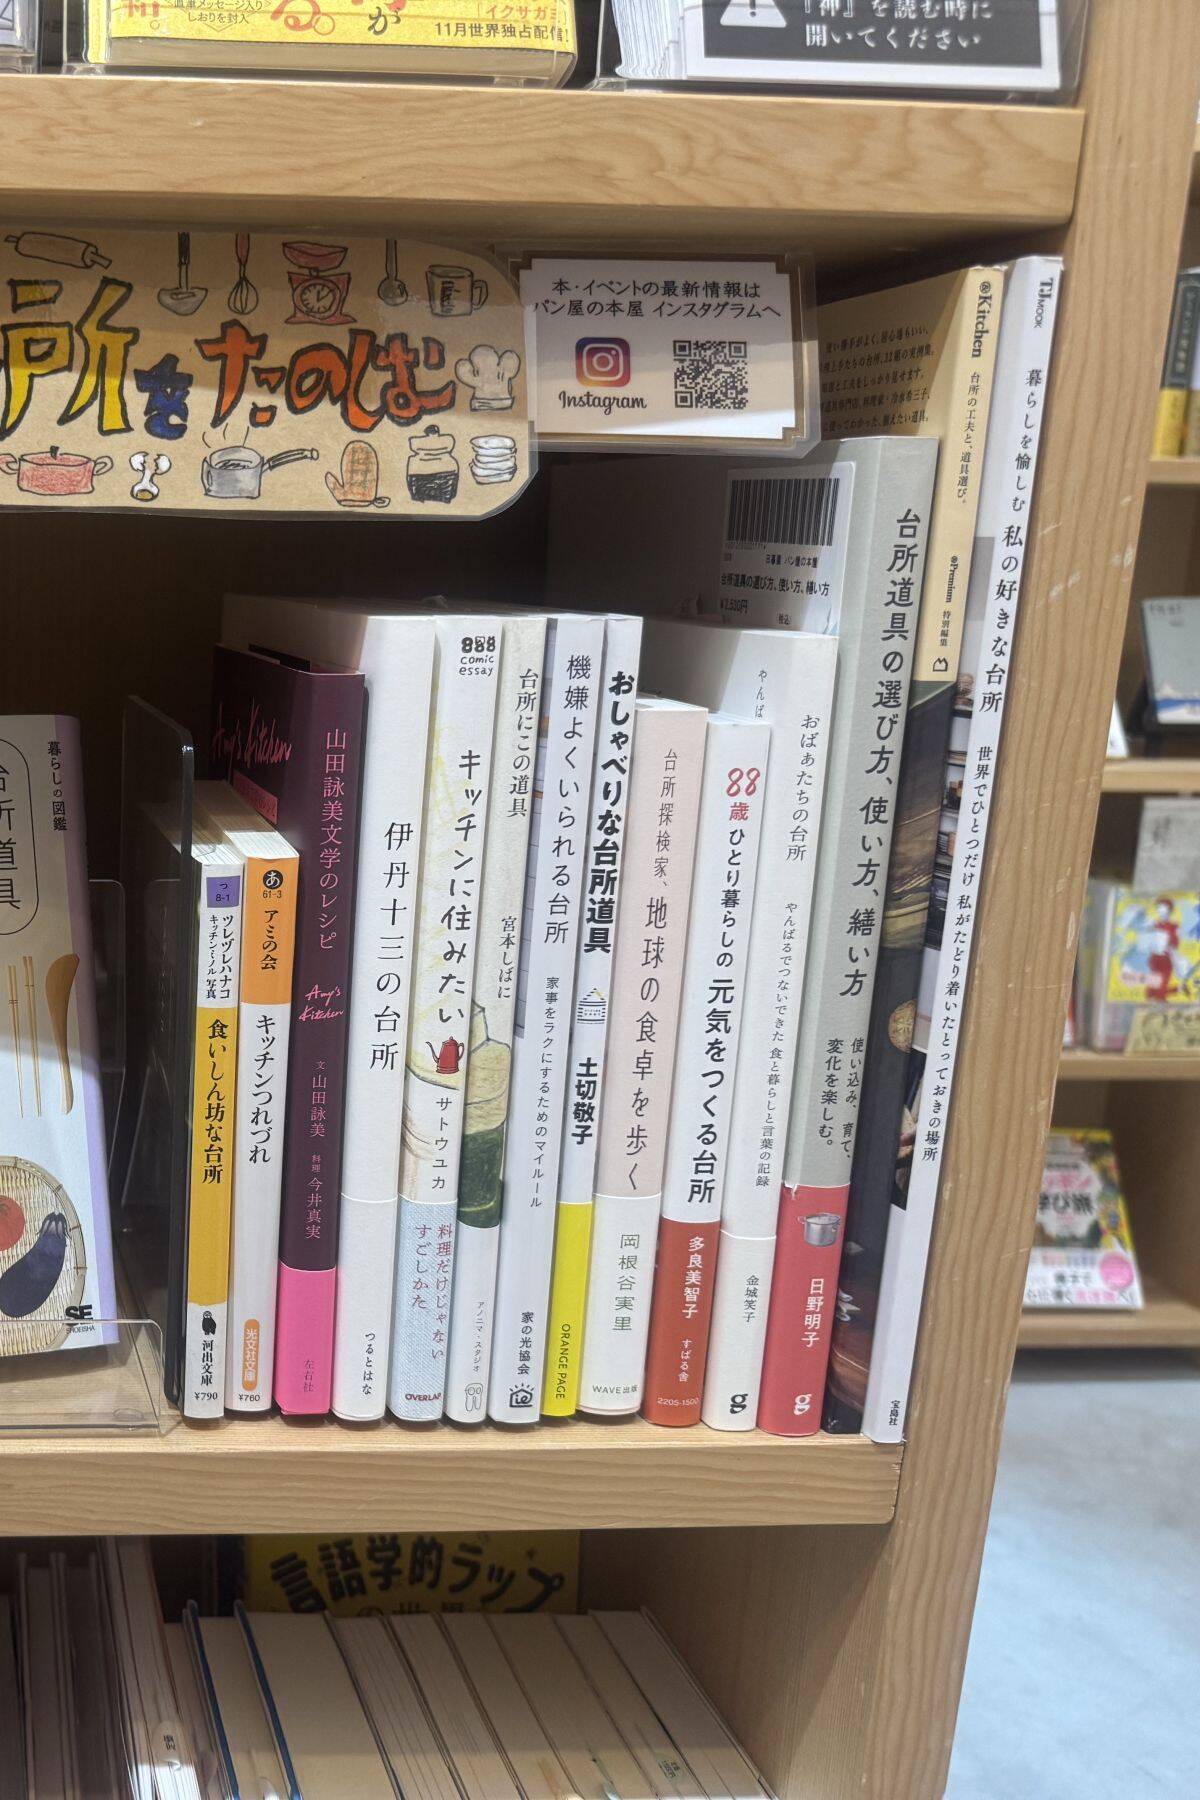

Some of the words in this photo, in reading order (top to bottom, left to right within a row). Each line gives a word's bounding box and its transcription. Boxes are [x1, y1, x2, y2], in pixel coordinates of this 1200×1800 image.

[187, 11, 251, 25] しおりを封入
[804, 23, 982, 49] 開いてください
[532, 299, 645, 318] パン屋の本屋
[652, 300, 783, 320] インスタグラムへ
[551, 276, 762, 299] 本・イベントの最新情報は
[558, 389, 648, 416] Instagram
[956, 371, 981, 504] 台所の工夫と、道具選び。
[1011, 368, 1043, 513] 暮らしを愉しむ
[460, 654, 495, 665] comic
[978, 525, 1025, 714] 私の好きな台所
[458, 666, 494, 677] essay
[507, 667, 540, 819] 台所にこの道具
[837, 507, 922, 997] 台所道具の選び方、使い方、繕い方
[47, 740, 68, 832] 暮らしの図鑑
[544, 653, 592, 945] 機嫌よくいられる台所
[583, 670, 636, 954] おしゃべりな台所道具
[785, 714, 821, 863] おばあたちの台所
[961, 746, 994, 886] 世界でひとつだけ
[265, 871, 281, 888] あ
[318, 727, 347, 950] 山田詠美文学のレシピ
[215, 893, 231, 902] 8-1
[262, 889, 283, 900] 61-3
[438, 749, 483, 1024] キッチンに住みたい
[219, 914, 235, 1000] ツレヅレハナコ
[260, 910, 280, 971] アミの会
[369, 821, 414, 1071] 伊丹十三の台所
[497, 915, 518, 1000] 宮本しばに
[771, 902, 799, 1043] やんばるでつないできた
[298, 1004, 345, 1022] Kitchen
[304, 984, 342, 1007] Amy's
[921, 894, 972, 1163] 私がたどり着いたとっておきの場所
[202, 1018, 230, 1185] 食いしん坊な台所
[248, 1014, 277, 1165] キッチンつれづれ
[309, 1073, 328, 1138] 山田詠美
[315, 1060, 326, 1070] 文
[530, 976, 560, 1208] 家事をラクにするためのマイルール
[571, 1056, 599, 1146] 土切敬子
[818, 1038, 844, 1147] 変化を楽しむ。
[431, 1096, 453, 1191] サトウユカ
[755, 1047, 784, 1188] 食と暮らしと言葉の記録
[310, 1153, 322, 1173] 料理
[305, 1176, 323, 1240] 今井真実
[411, 1223, 432, 1310] すごしかた
[431, 1223, 453, 1361] 料理だけじゃない
[611, 1233, 641, 1332] 岡根谷実里
[681, 1236, 706, 1319] 多良美智子
[742, 1274, 760, 1324] 金城笑子
[516, 1311, 535, 1376] 家の光協会
[558, 1323, 572, 1370] ORANGE
[800, 1278, 826, 1349] 日野明子
[200, 1339, 215, 1387] 河出文庫
[302, 1358, 315, 1393] 左右社
[361, 1330, 377, 1396] つるとはな
[555, 1372, 569, 1400] PAGE
[677, 1338, 693, 1382] すばる舎
